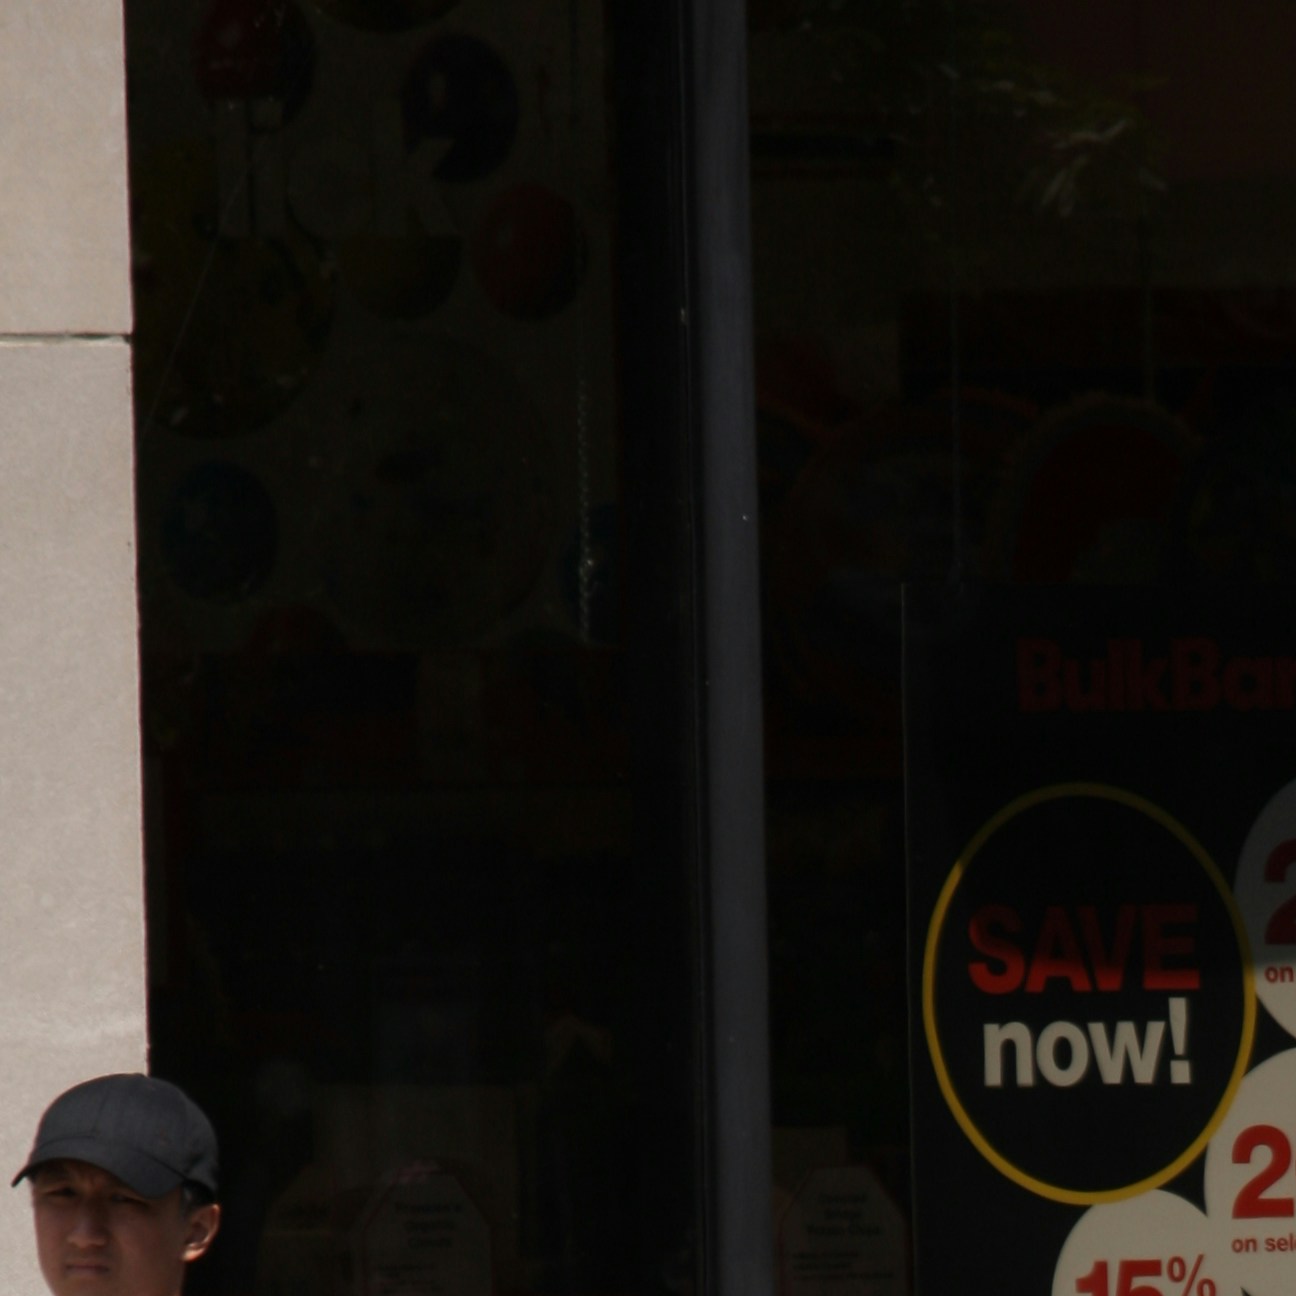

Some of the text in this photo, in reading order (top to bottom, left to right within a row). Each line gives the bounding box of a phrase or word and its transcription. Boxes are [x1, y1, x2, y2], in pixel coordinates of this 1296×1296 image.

[967, 901, 1201, 996] SAVE
[1264, 965, 1294, 983] on
[982, 997, 1192, 1088] now!
[1231, 1234, 1258, 1253] on
